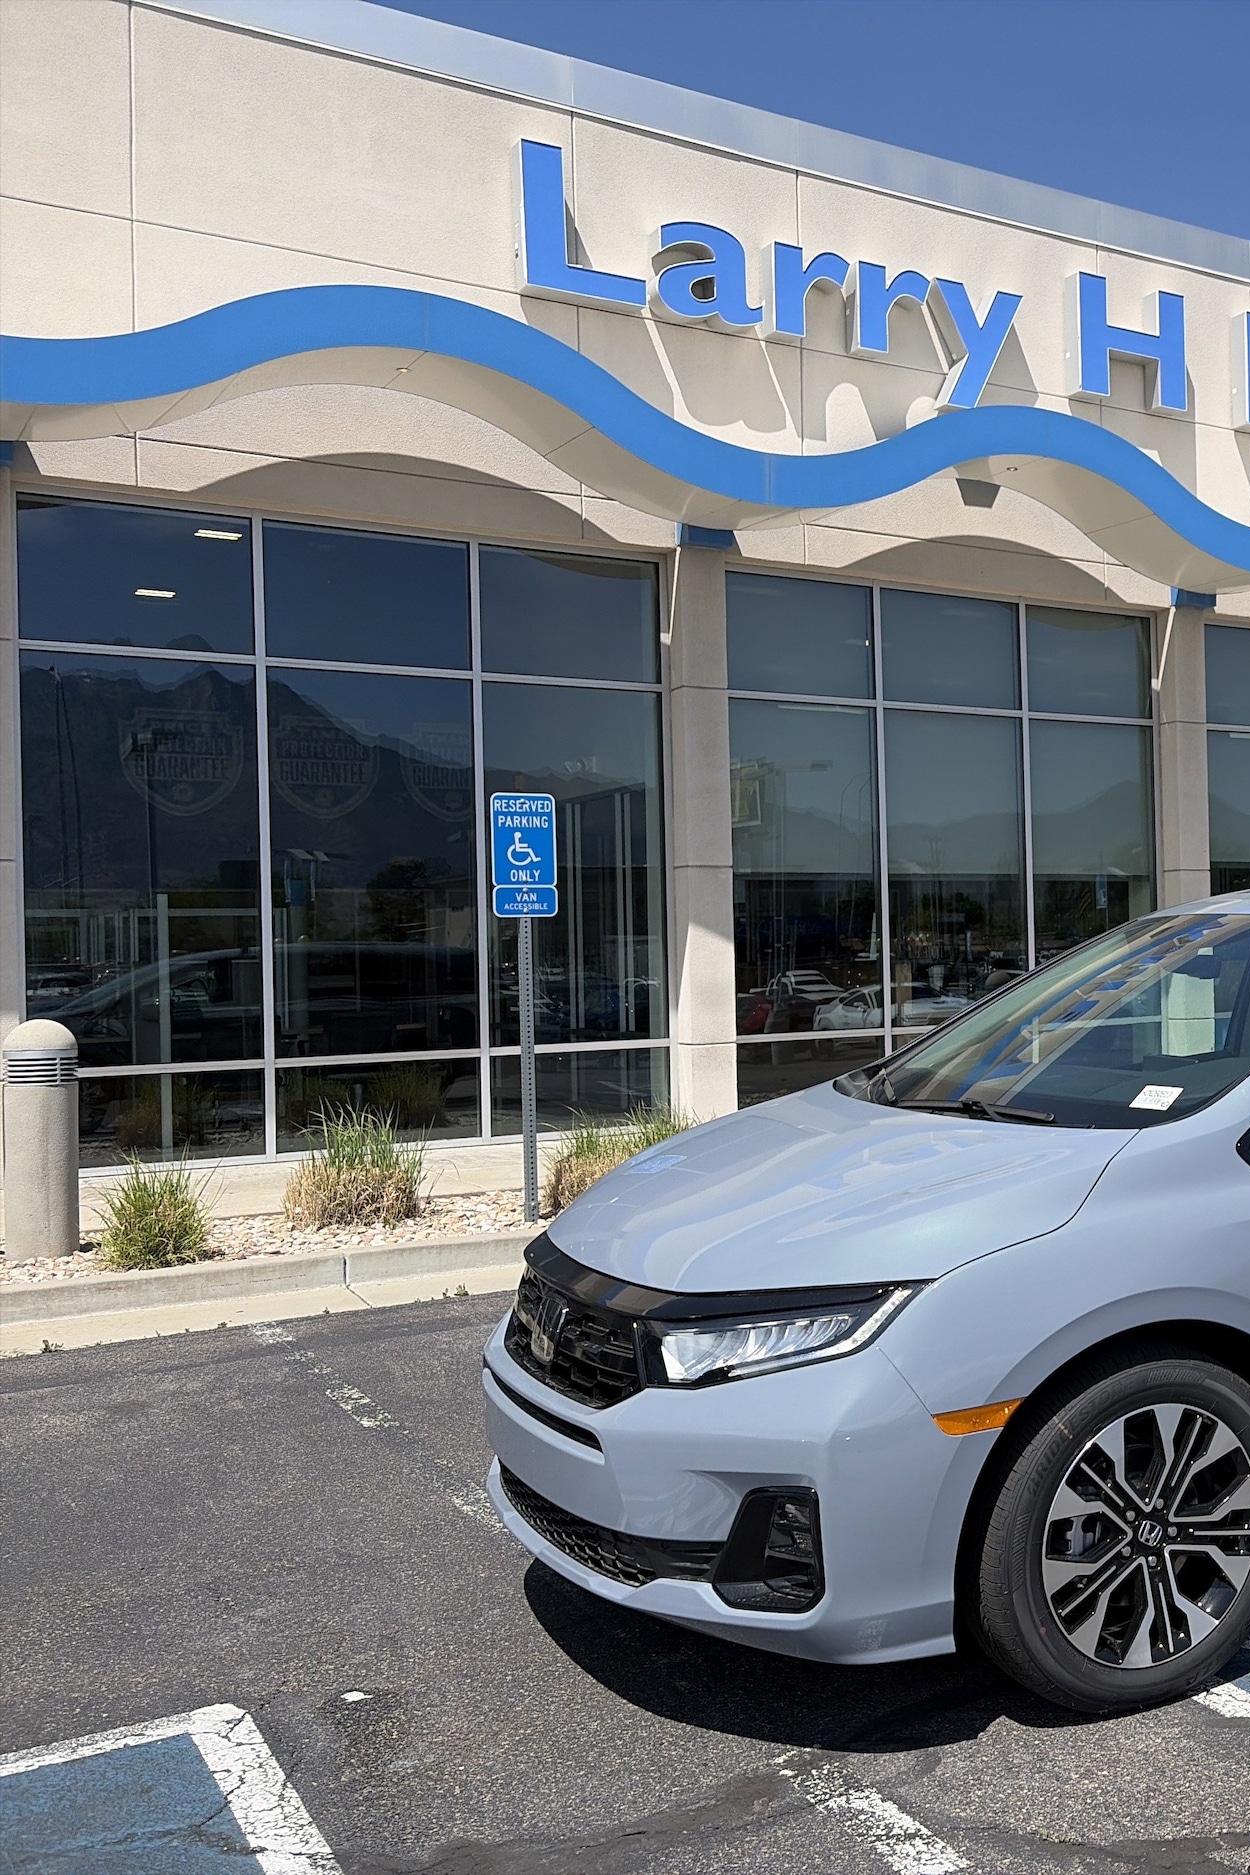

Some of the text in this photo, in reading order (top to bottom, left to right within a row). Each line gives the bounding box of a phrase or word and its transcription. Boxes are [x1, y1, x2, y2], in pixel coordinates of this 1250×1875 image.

[517, 138, 1023, 410] Larry
[1074, 271, 1188, 412] H
[135, 754, 229, 780] GUARANTEE
[279, 760, 366, 785] GUARANTEE
[412, 765, 470, 787] GUARAN
[493, 799, 551, 812] RESERVED
[498, 816, 549, 828] PARKING
[510, 869, 541, 882] ONLY
[515, 892, 537, 902] VAN
